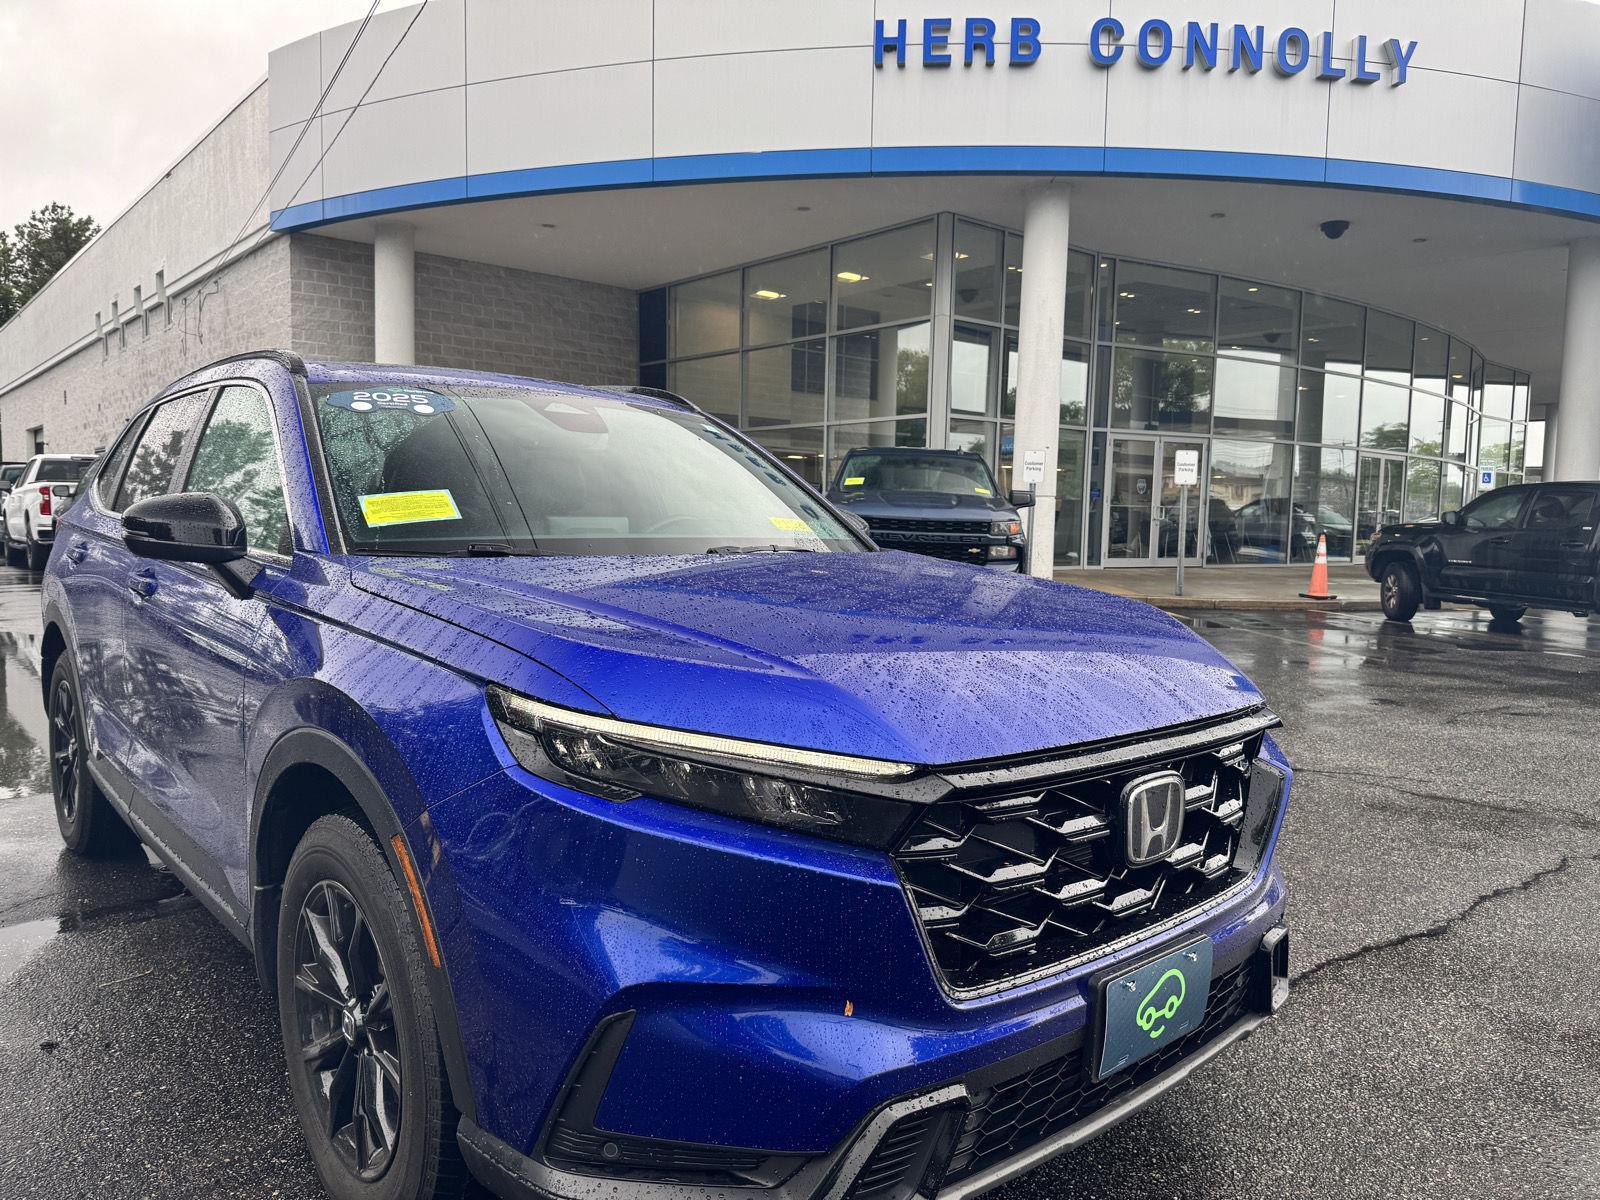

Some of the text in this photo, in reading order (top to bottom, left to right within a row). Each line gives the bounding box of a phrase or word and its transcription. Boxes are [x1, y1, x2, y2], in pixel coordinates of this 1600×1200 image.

[874, 17, 1418, 87] HERB CONNOLLY
[353, 391, 429, 404] 2025
[871, 532, 989, 545] HEVROLET
